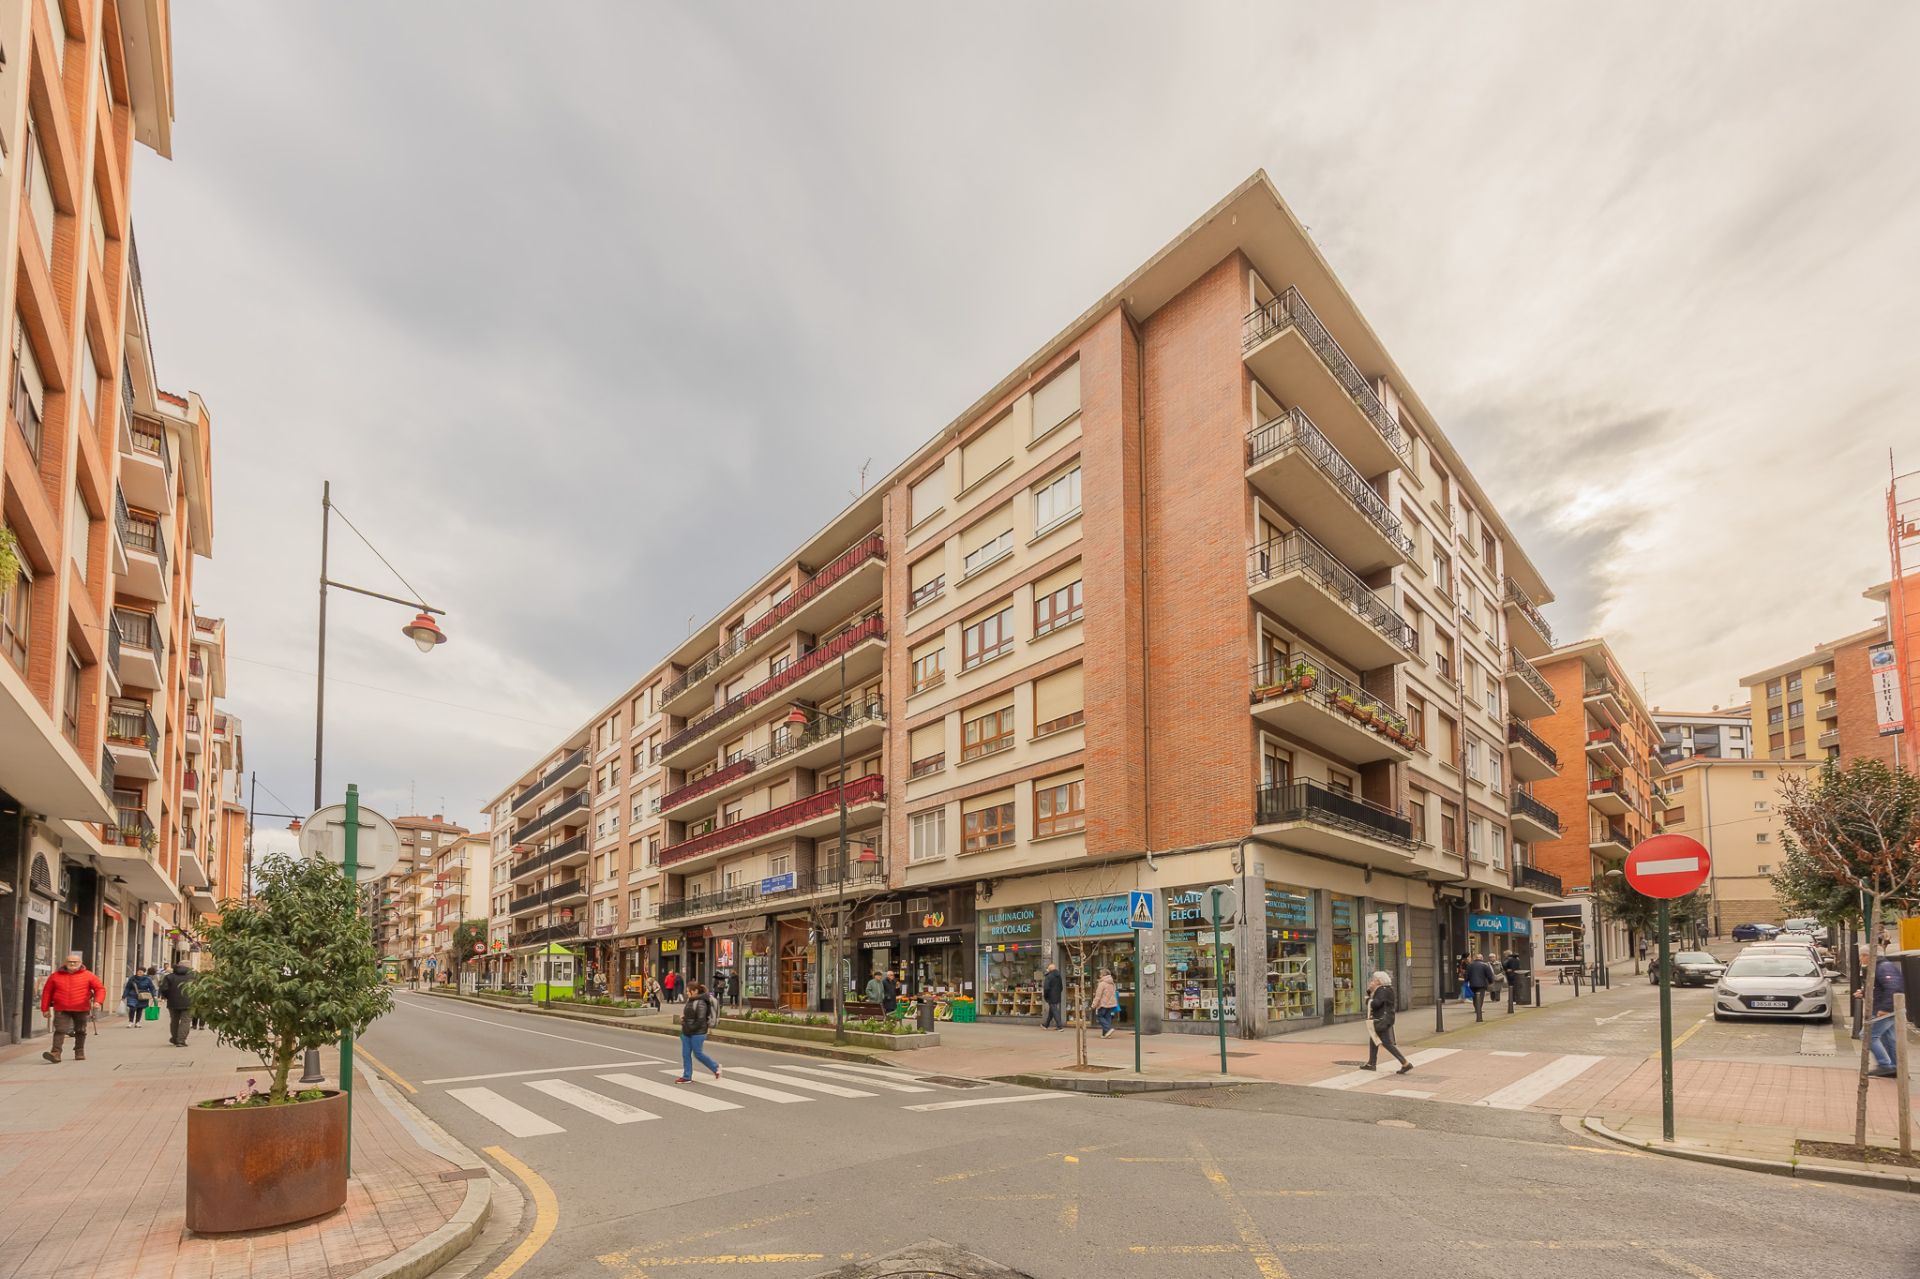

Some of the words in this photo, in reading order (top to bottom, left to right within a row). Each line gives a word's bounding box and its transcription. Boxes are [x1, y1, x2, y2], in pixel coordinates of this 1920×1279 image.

[1173, 894, 1202, 905] MATE
[1171, 908, 1202, 921] ELECT
[991, 924, 1032, 936] BRICOLAGE
